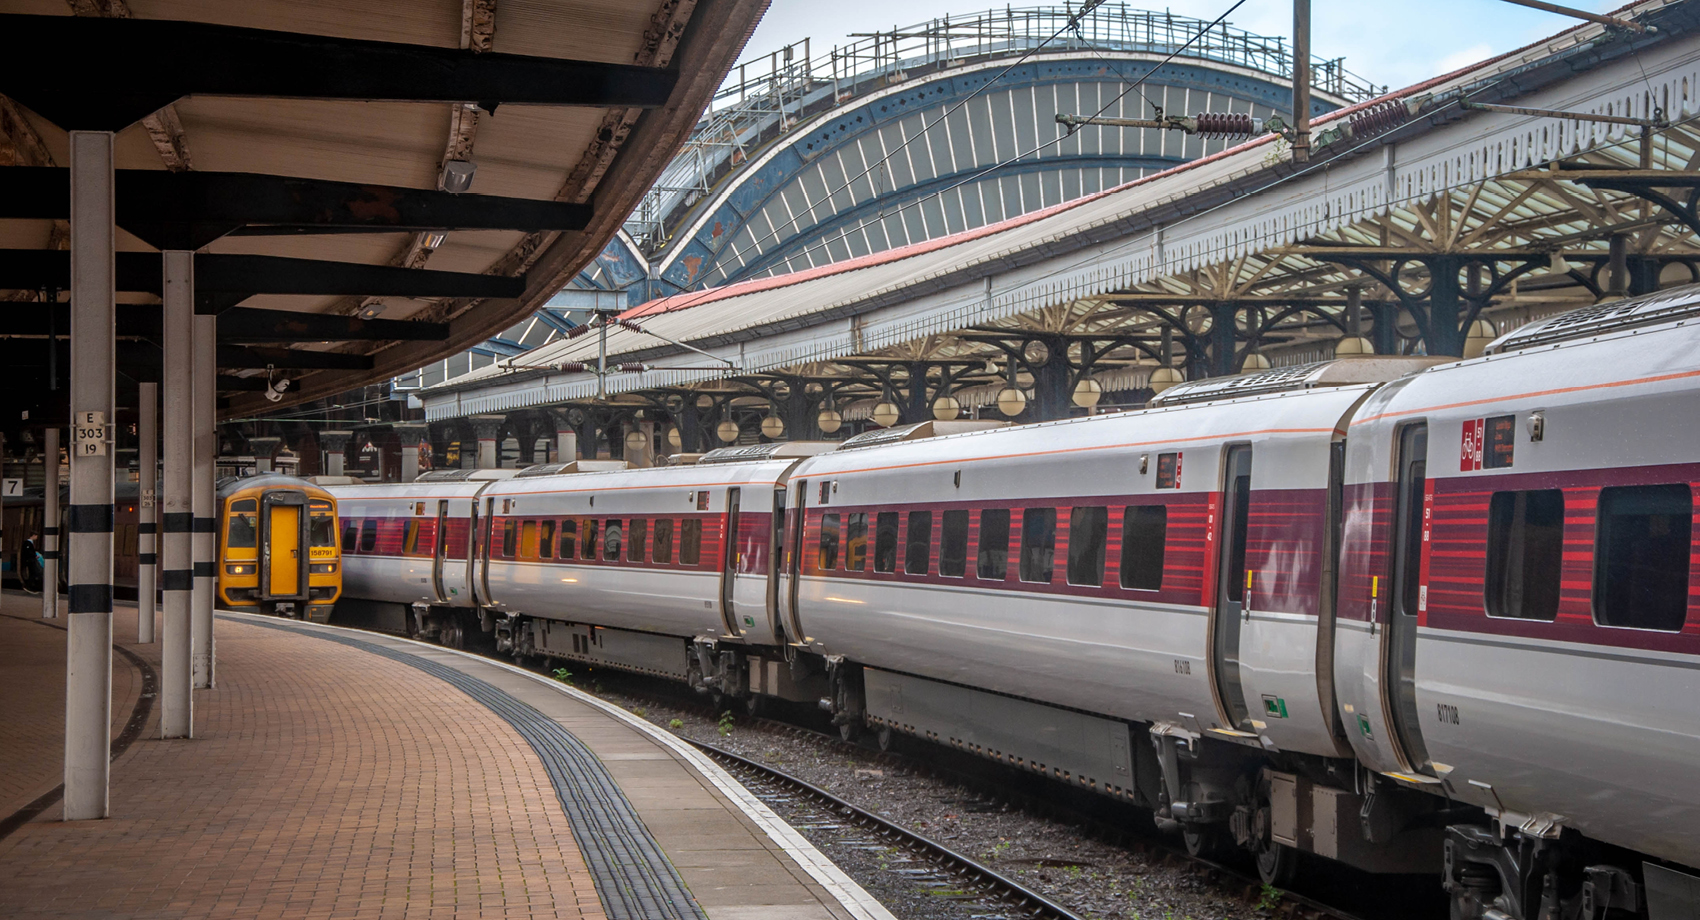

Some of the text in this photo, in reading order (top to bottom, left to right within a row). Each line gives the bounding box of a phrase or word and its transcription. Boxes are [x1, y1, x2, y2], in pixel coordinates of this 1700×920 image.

[86, 413, 94, 424] E
[79, 428, 103, 439] 303
[1476, 427, 1482, 438] 51
[85, 444, 97, 454] 19
[7, 481, 18, 494] 7
[1425, 508, 1431, 519] 51
[310, 549, 333, 557] 158791
[1174, 659, 1191, 675] 816108
[1437, 703, 1460, 725] 817108
